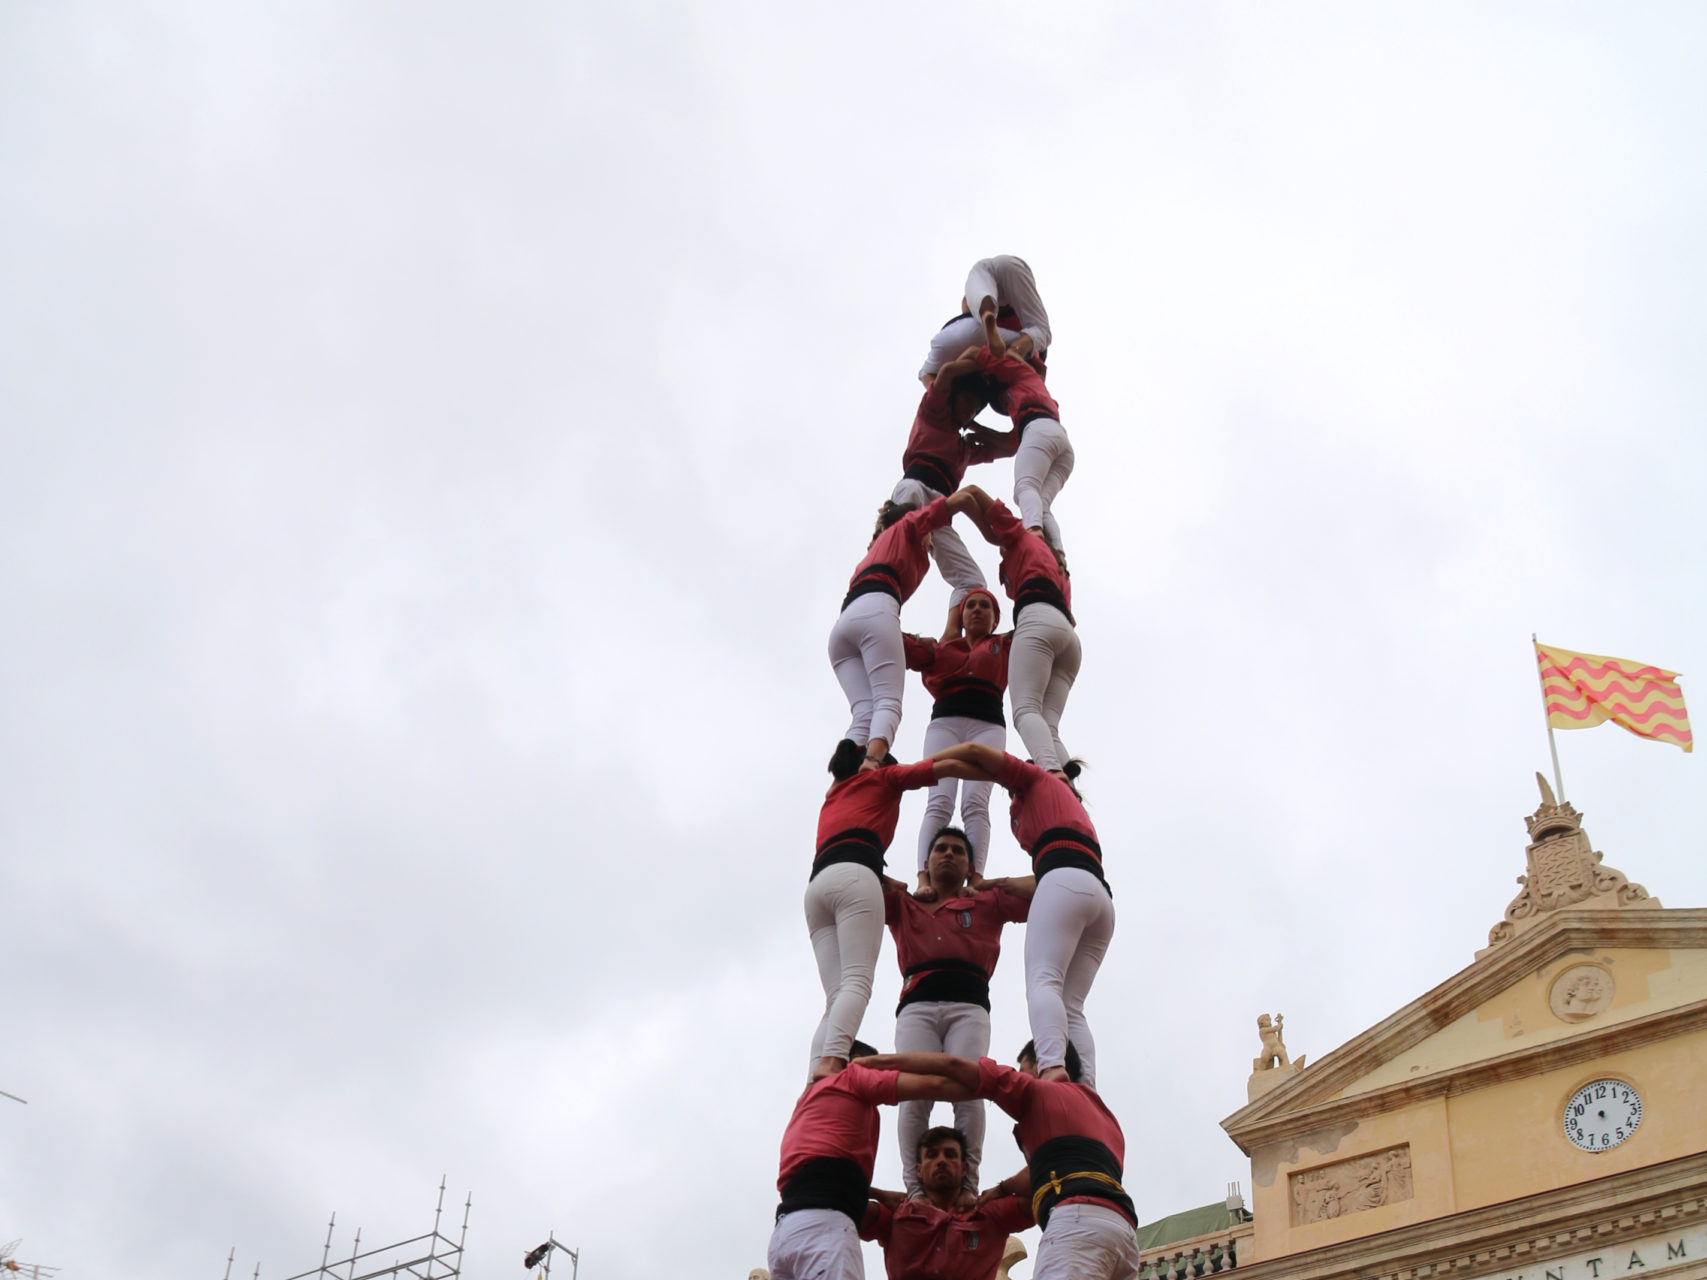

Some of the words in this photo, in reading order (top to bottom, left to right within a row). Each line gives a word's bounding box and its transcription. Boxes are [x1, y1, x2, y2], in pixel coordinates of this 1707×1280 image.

[1583, 1092, 1593, 1105] 11
[1595, 1085, 1607, 1100] 12
[1612, 1086, 1617, 1099] 1
[1622, 1090, 1630, 1104] 2
[1573, 1103, 1585, 1117] 10
[1629, 1103, 1638, 1116] 3
[1569, 1117, 1578, 1131] 9
[1625, 1116, 1633, 1128] 4
[1576, 1128, 1584, 1141] 8
[1587, 1133, 1595, 1146] 7
[1601, 1133, 1610, 1146] 6
[1615, 1127, 1624, 1140] 5
